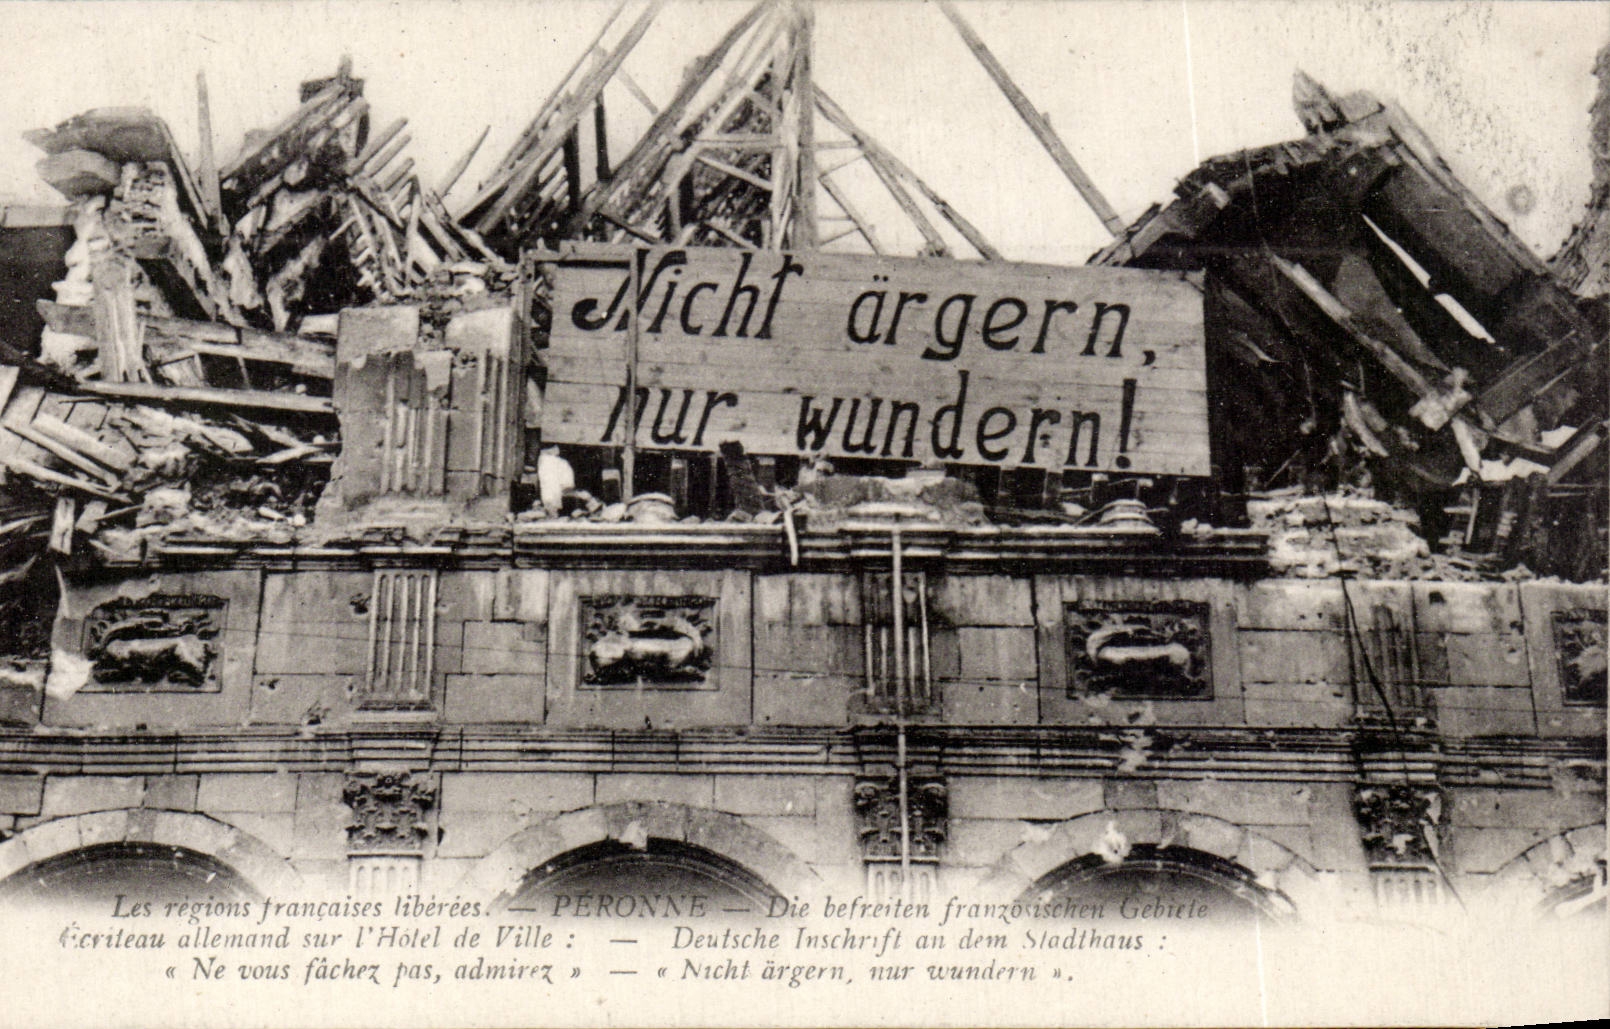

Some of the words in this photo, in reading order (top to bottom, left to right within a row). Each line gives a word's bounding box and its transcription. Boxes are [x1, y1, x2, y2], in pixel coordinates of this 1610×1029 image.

[571, 248, 804, 339] Nicht
[846, 274, 1157, 366] ärgern,
[601, 384, 738, 446] nur
[797, 370, 1137, 469] wundern!
